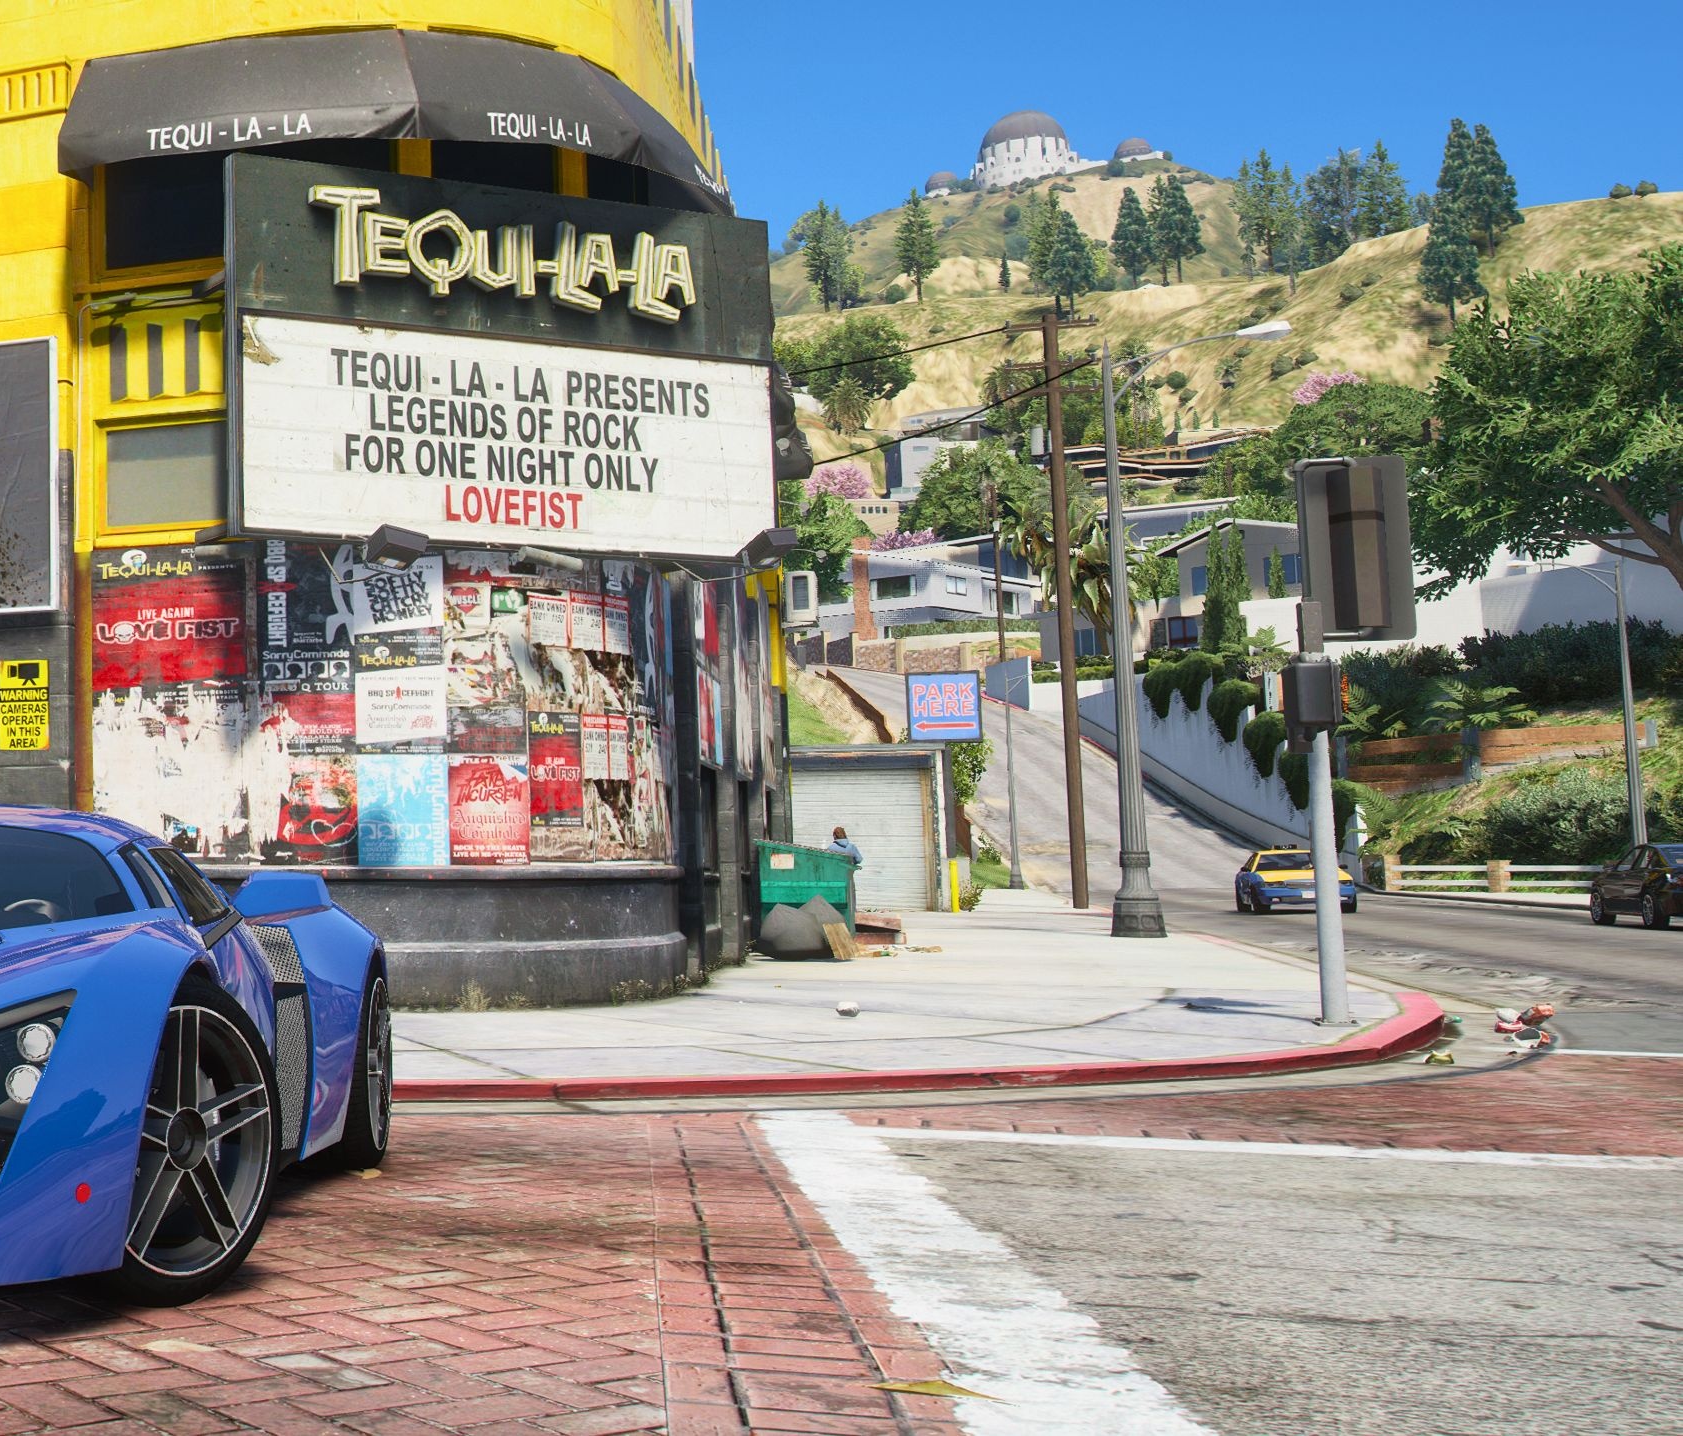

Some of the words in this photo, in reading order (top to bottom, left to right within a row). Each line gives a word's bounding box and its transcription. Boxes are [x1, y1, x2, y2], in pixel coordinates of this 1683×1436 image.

[147, 121, 212, 150] TEQUI
[234, 117, 261, 142] LA
[284, 113, 312, 135] LA
[487, 111, 538, 138] TEQUI
[549, 118, 566, 143] LA
[575, 123, 592, 148] LA
[330, 348, 422, 393] TEQUI
[450, 359, 487, 398] LA
[513, 365, 550, 404] LA
[567, 370, 710, 419] PRESENTS
[369, 393, 507, 441] LEGENDS
[517, 406, 553, 444] OF
[564, 410, 642, 452] ROCK
[344, 434, 405, 474] FOR
[415, 438, 476, 480] ONE
[487, 445, 575, 488] NIGHT
[583, 453, 659, 493] ONLY
[444, 484, 583, 530] LOVEFIST
[138, 608, 157, 620] LIVE
[160, 607, 195, 619] AGAIN!
[372, 603, 432, 624] MONKEY
[530, 601, 544, 610] BANK
[546, 602, 566, 613] OWNED
[175, 618, 239, 640] FIST
[262, 649, 350, 661] SorryCommode
[314, 682, 349, 690] TOUR
[912, 682, 974, 700] PARK
[0, 688, 48, 702] WARNING
[0, 703, 47, 714] CAMERAS
[913, 700, 976, 717] HERE
[1, 715, 45, 725] OPERATE
[7, 727, 16, 737] IN
[19, 726, 41, 737] THIS
[9, 738, 38, 748] AREA!
[559, 766, 580, 782] FIST
[455, 809, 526, 825] Anguished
